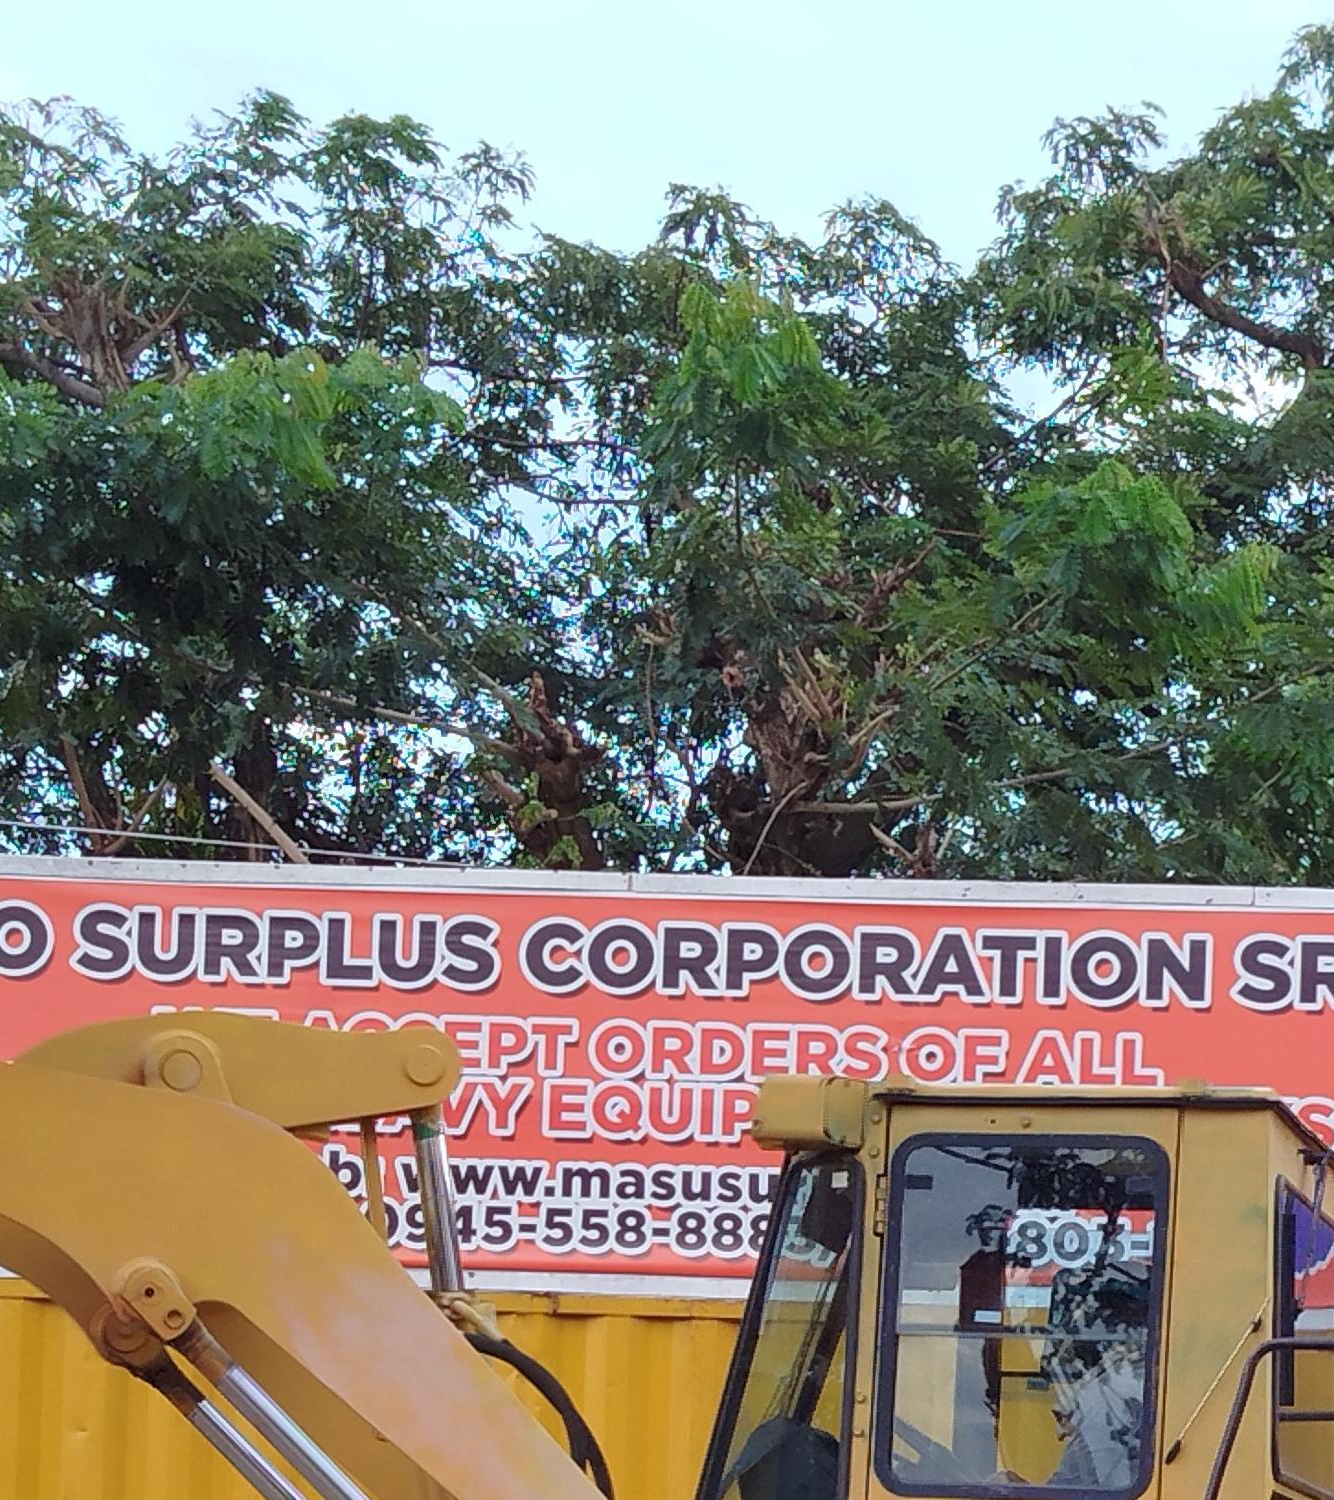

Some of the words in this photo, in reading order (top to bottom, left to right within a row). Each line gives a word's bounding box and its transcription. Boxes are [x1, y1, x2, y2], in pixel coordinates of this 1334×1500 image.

[74, 906, 498, 983] SURPLUS
[524, 918, 1209, 1001] CORPORATION
[590, 1022, 885, 1079] ORDERS
[899, 1030, 1007, 1083] OF
[1025, 1032, 1161, 1083] ALL
